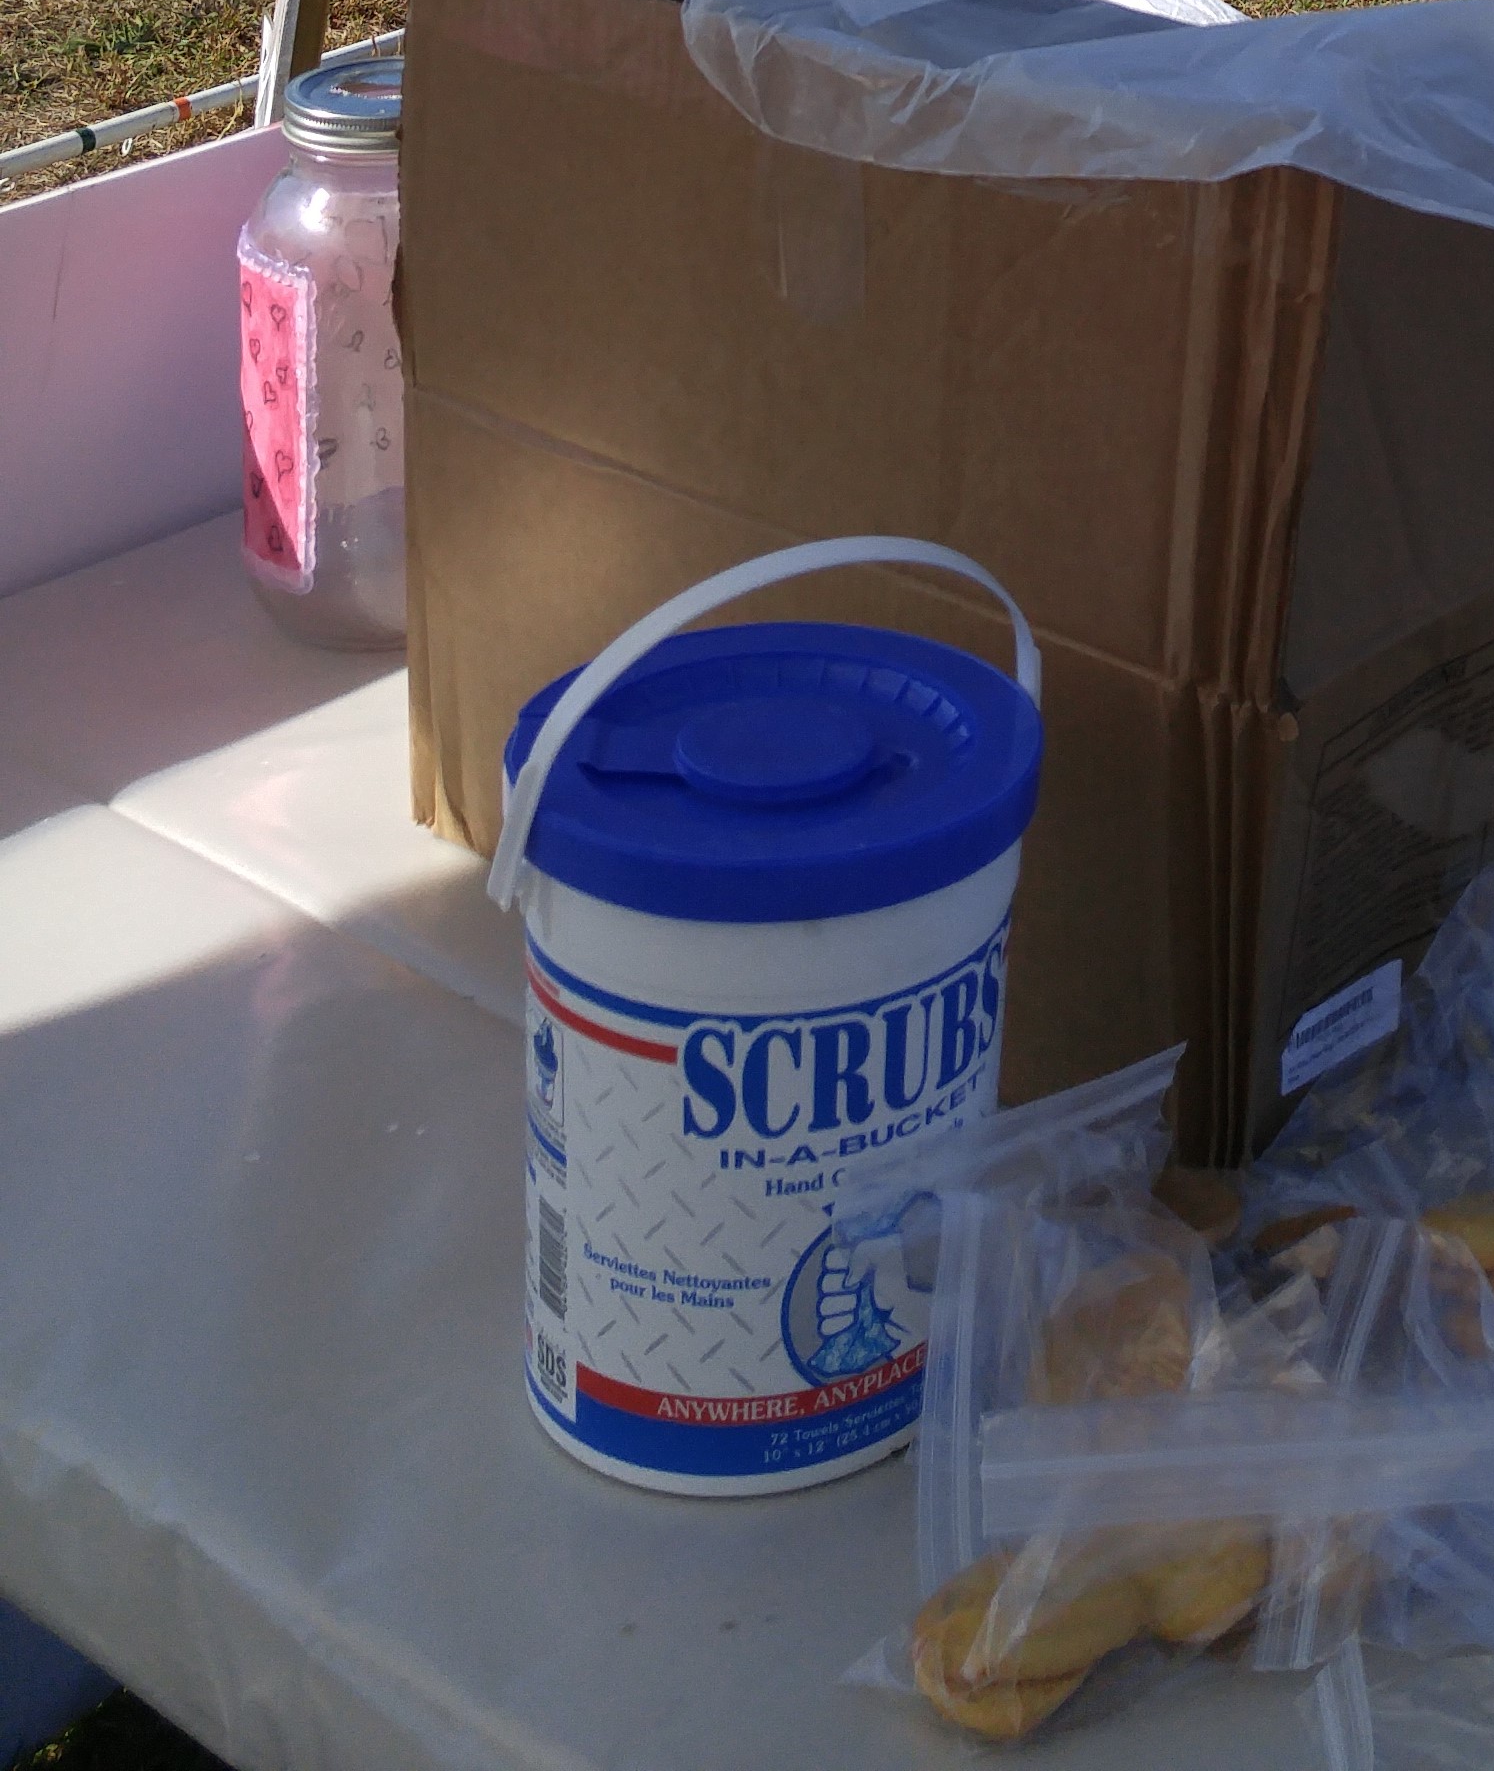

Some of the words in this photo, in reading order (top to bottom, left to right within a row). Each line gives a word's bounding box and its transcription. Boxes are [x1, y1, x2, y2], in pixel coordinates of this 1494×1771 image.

[683, 943, 1001, 1140] SCRUBS
[719, 1063, 986, 1170] IN-A-BUCKET
[765, 1172, 824, 1197] Hand
[583, 1242, 656, 1281] Serviettes
[663, 1269, 771, 1293] Nettoyantes
[610, 1278, 646, 1297] pour
[651, 1285, 675, 1303] les
[681, 1290, 735, 1308] Mains
[537, 1332, 567, 1387] SDS
[657, 1396, 806, 1422] ANYWHERE,
[814, 1347, 926, 1409] ANYPLACE
[771, 1432, 788, 1446] 72
[794, 1424, 839, 1442] Towels
